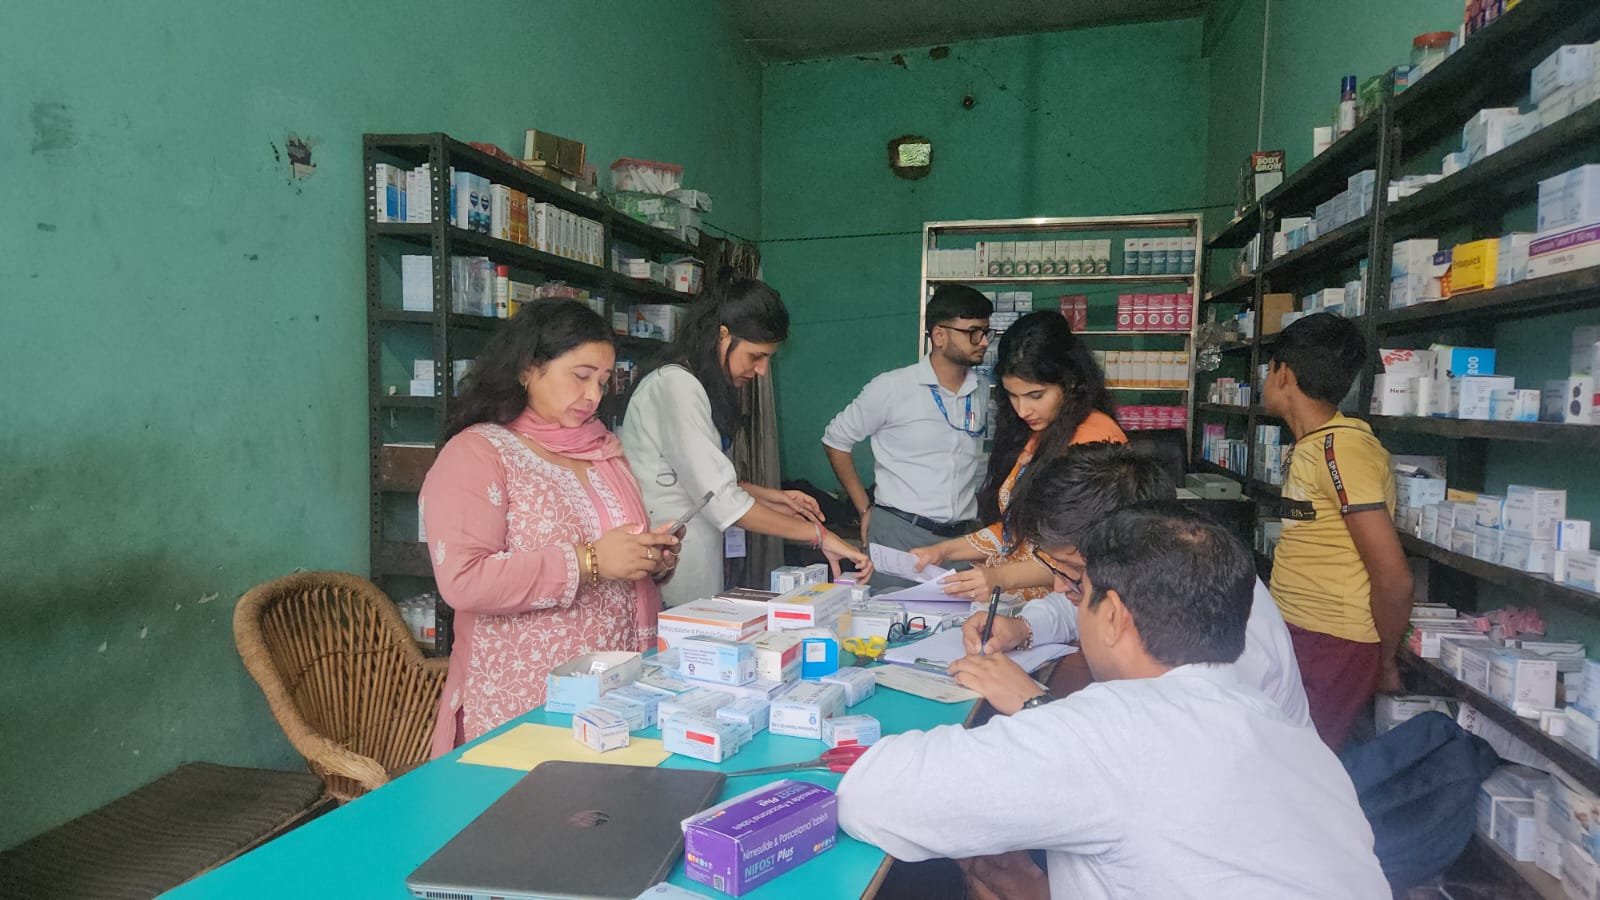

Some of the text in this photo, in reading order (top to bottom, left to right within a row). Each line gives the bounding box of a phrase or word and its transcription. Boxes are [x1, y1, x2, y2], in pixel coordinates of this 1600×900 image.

[1256, 163, 1281, 171] GROW
[1257, 156, 1280, 165] BODY
[1328, 461, 1343, 490] SPORTS
[743, 840, 773, 861] Nimesulide
[779, 820, 811, 844] Paracetamol
[744, 846, 794, 879] NIFOST Plus
